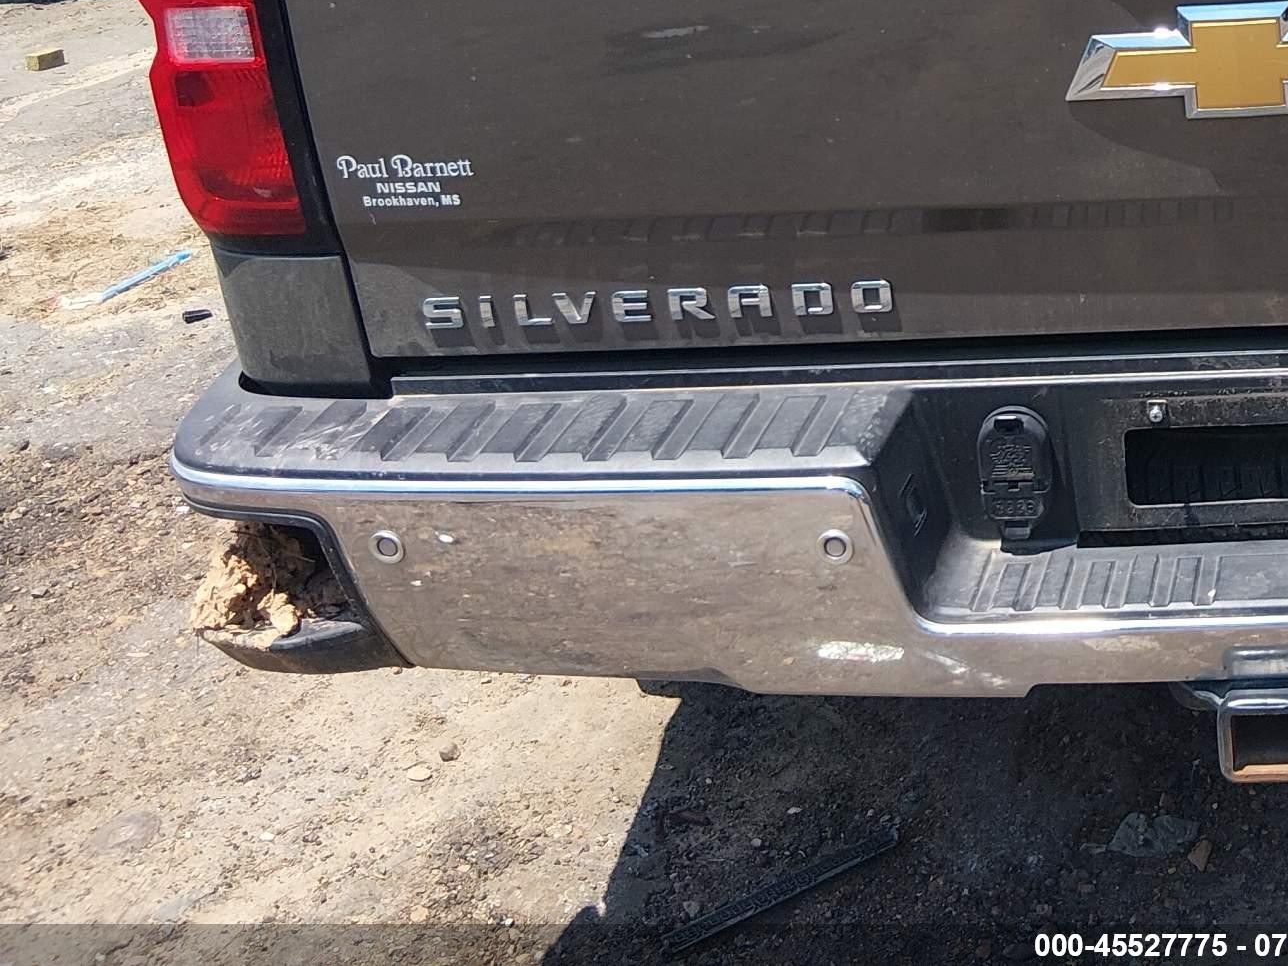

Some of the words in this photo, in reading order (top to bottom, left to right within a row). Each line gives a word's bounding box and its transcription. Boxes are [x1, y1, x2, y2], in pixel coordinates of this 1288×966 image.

[336, 155, 389, 178] Paul
[391, 154, 475, 178] Barnett
[376, 182, 441, 193] NISSAN
[362, 195, 440, 207] Brookhaven,
[441, 194, 461, 206] MS
[422, 279, 894, 330] SILVERADO
